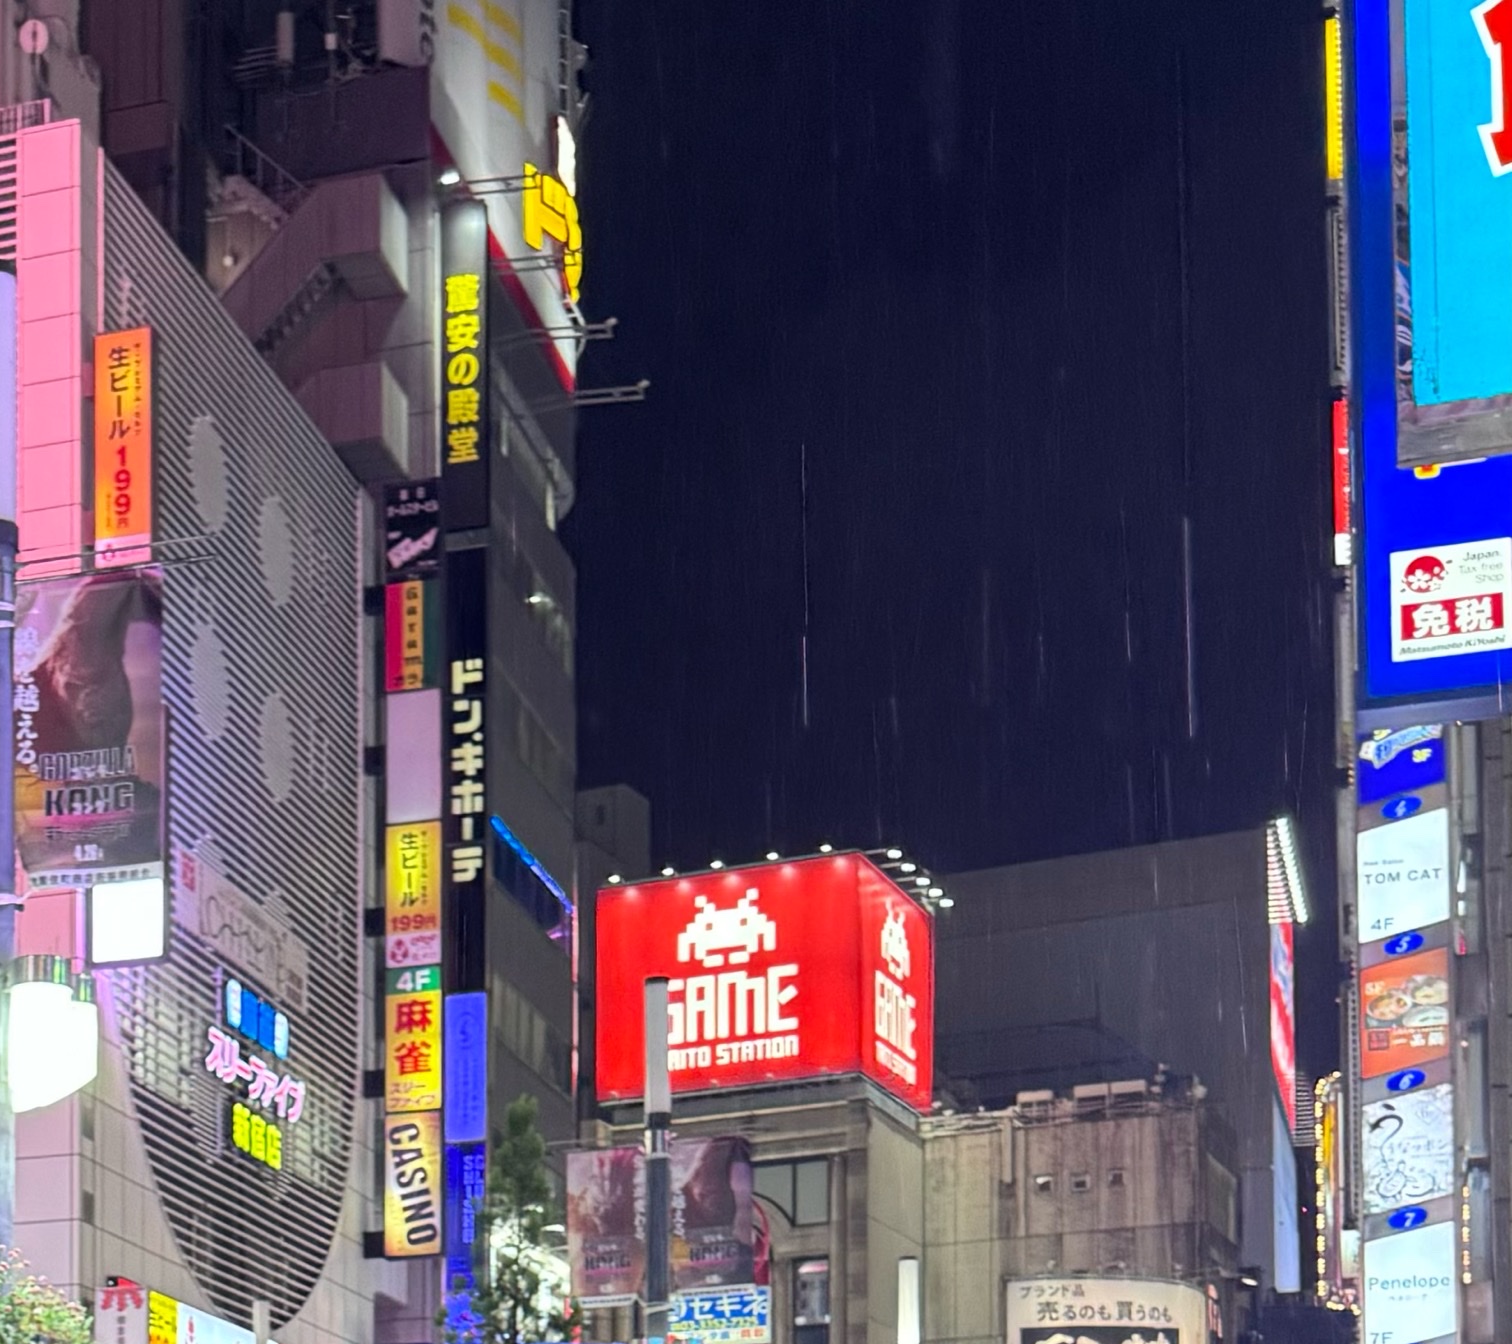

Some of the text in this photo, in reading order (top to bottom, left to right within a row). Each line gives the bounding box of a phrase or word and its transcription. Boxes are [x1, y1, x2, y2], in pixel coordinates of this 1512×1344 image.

[445, 273, 480, 464] 驚安の殿堂
[108, 346, 131, 440] 生ビール
[1412, 596, 1494, 639] 免税
[45, 781, 134, 816] KONG
[400, 832, 419, 907] 生ビール
[1364, 867, 1442, 885] TOM CAT
[1370, 917, 1394, 930] 4F
[396, 969, 431, 991] 4F
[394, 999, 432, 1076] 麻雀
[668, 1035, 799, 1071] AITO STATION
[389, 1122, 438, 1247] CASINO
[1019, 1284, 1086, 1299] ブランド品
[1368, 1274, 1450, 1291] Penelope
